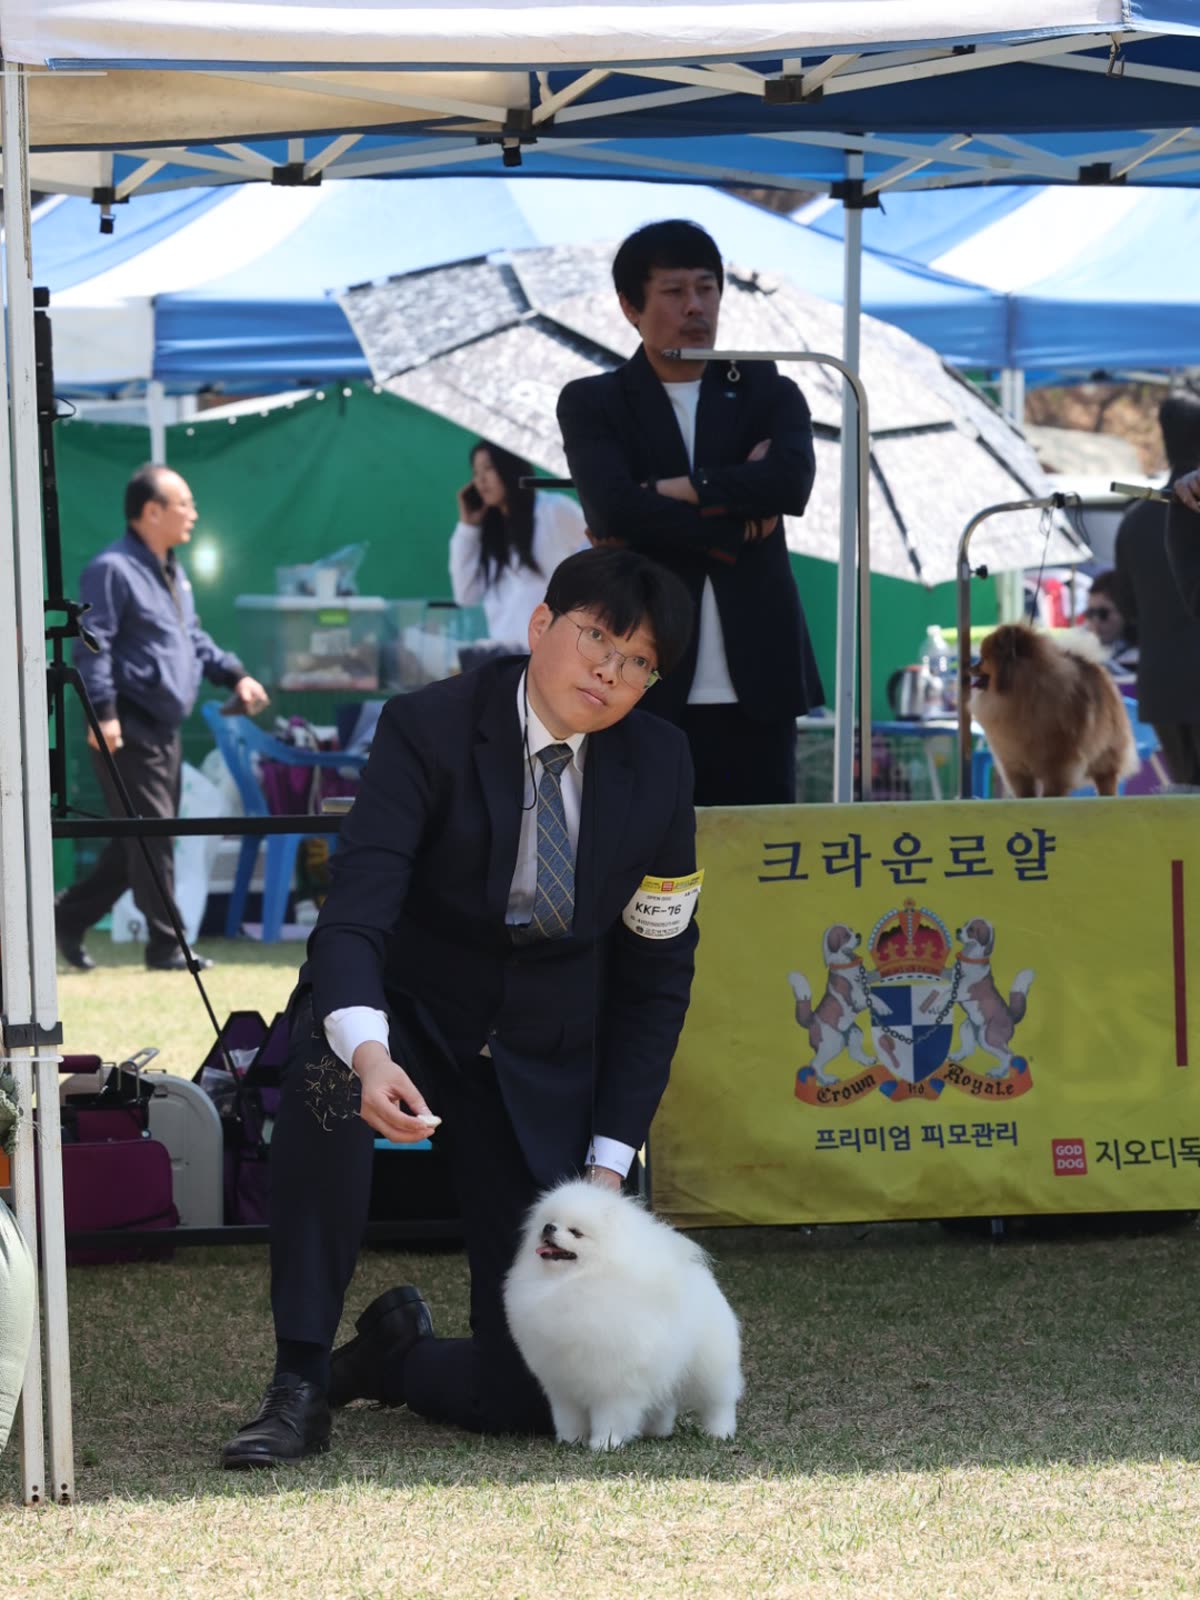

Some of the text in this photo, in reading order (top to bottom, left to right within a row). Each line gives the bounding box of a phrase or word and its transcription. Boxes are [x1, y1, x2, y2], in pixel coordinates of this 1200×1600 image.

[758, 828, 1056, 888] 크라운로얄
[635, 902, 682, 916] KKF-76
[816, 1074, 876, 1103] Crown
[815, 1121, 1018, 1152] 프리미엄 피모관리
[1055, 1144, 1082, 1156] GOD
[1056, 1158, 1084, 1169] DOG
